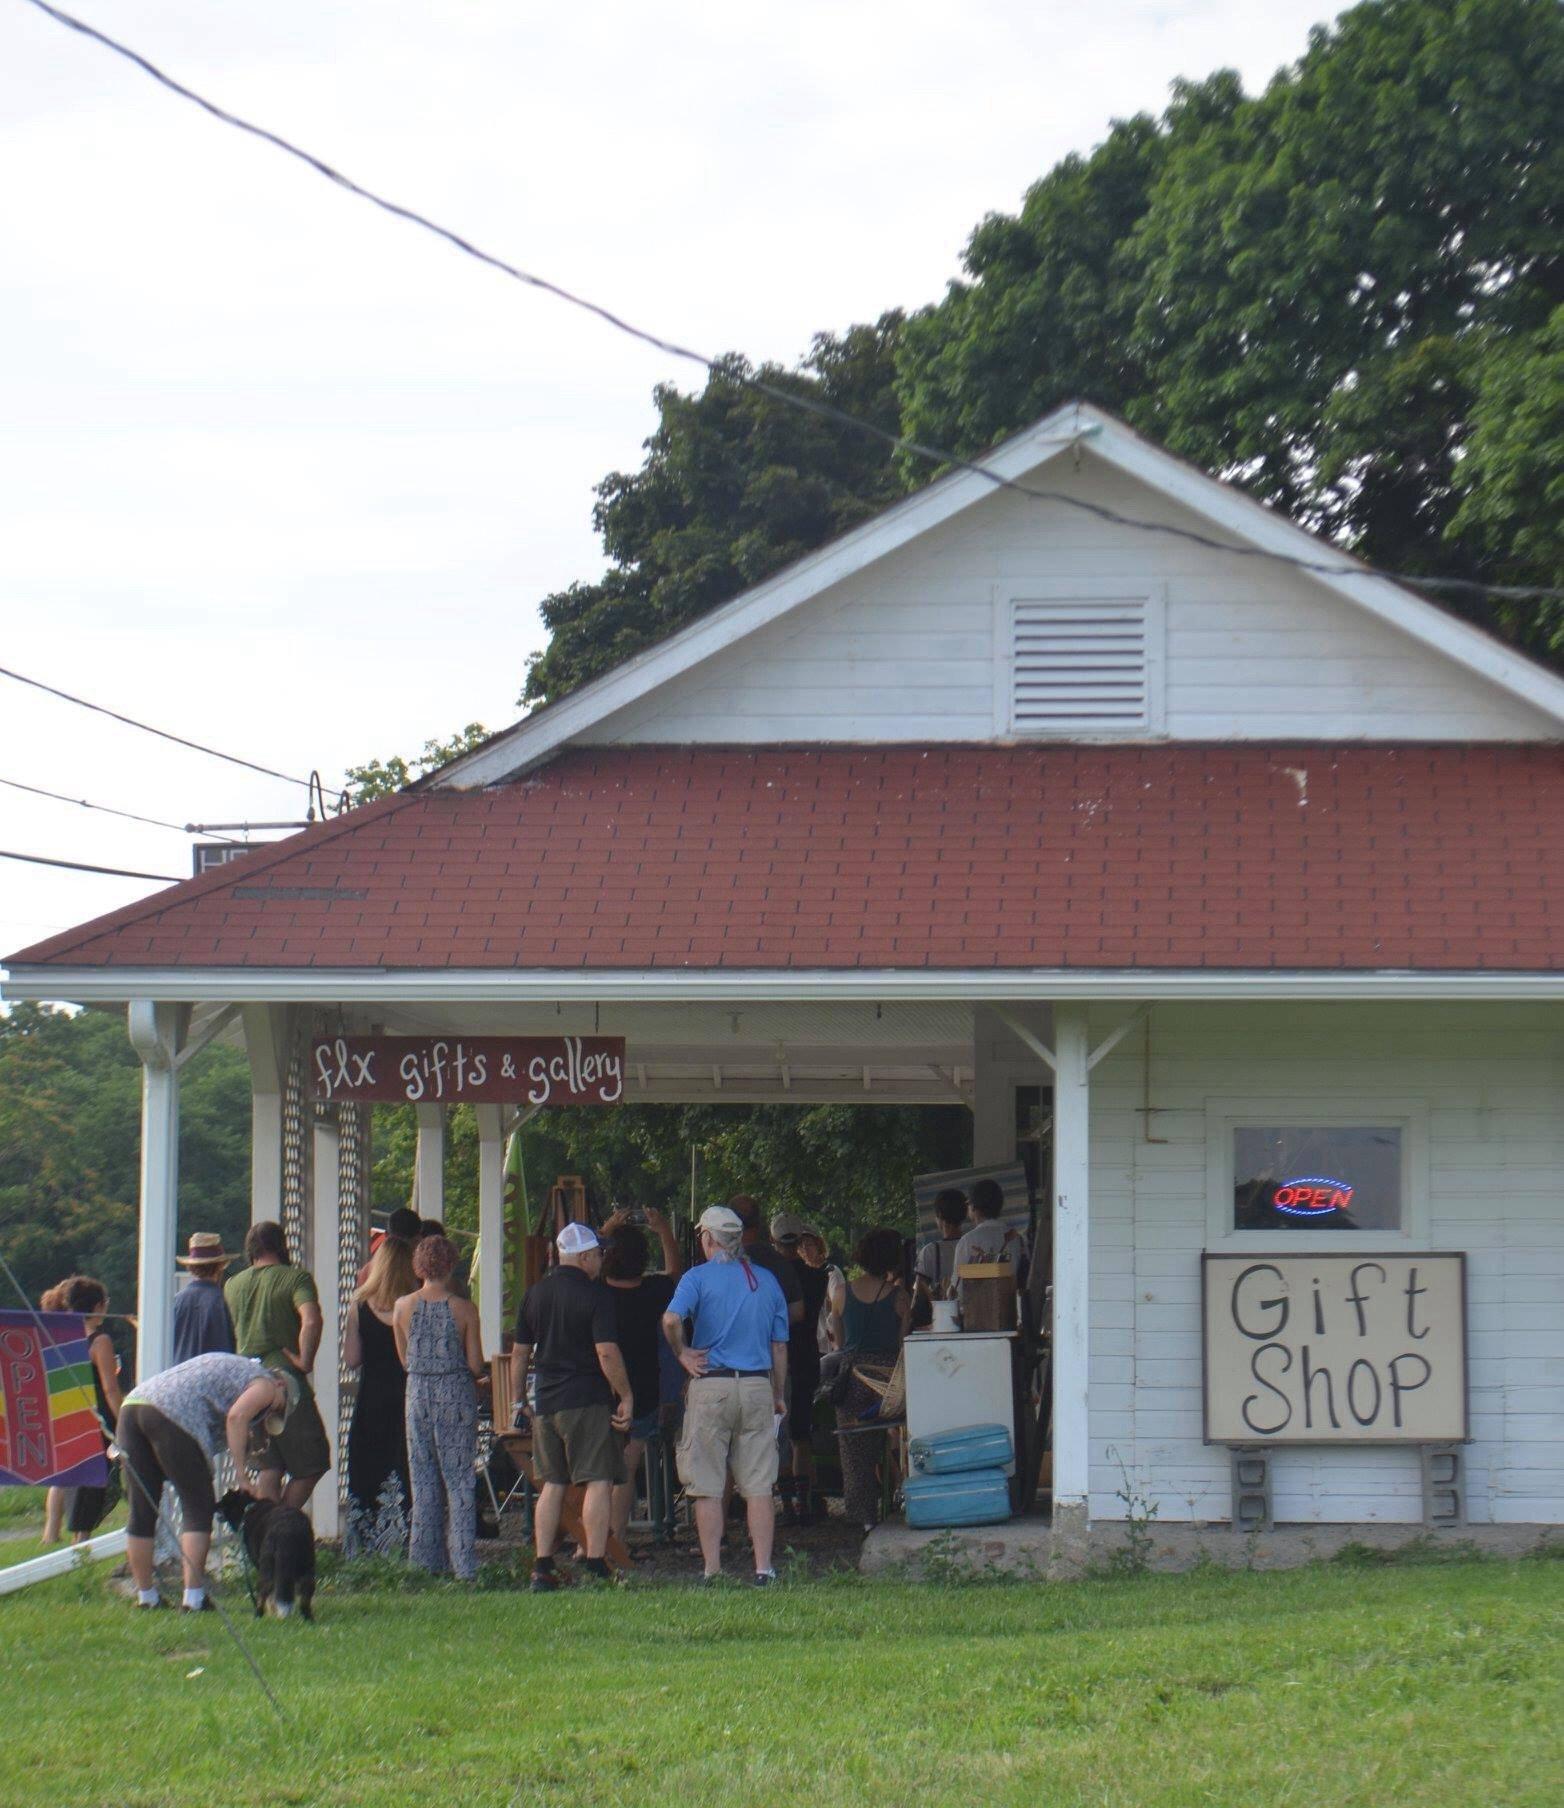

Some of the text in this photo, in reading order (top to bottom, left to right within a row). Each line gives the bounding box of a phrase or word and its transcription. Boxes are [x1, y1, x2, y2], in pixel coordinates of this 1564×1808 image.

[316, 1037, 622, 1104] flx gifts & gallery
[1274, 1187, 1354, 1209] OPEN
[1232, 1263, 1430, 1340] Gift
[1, 1329, 47, 1467] OPEN
